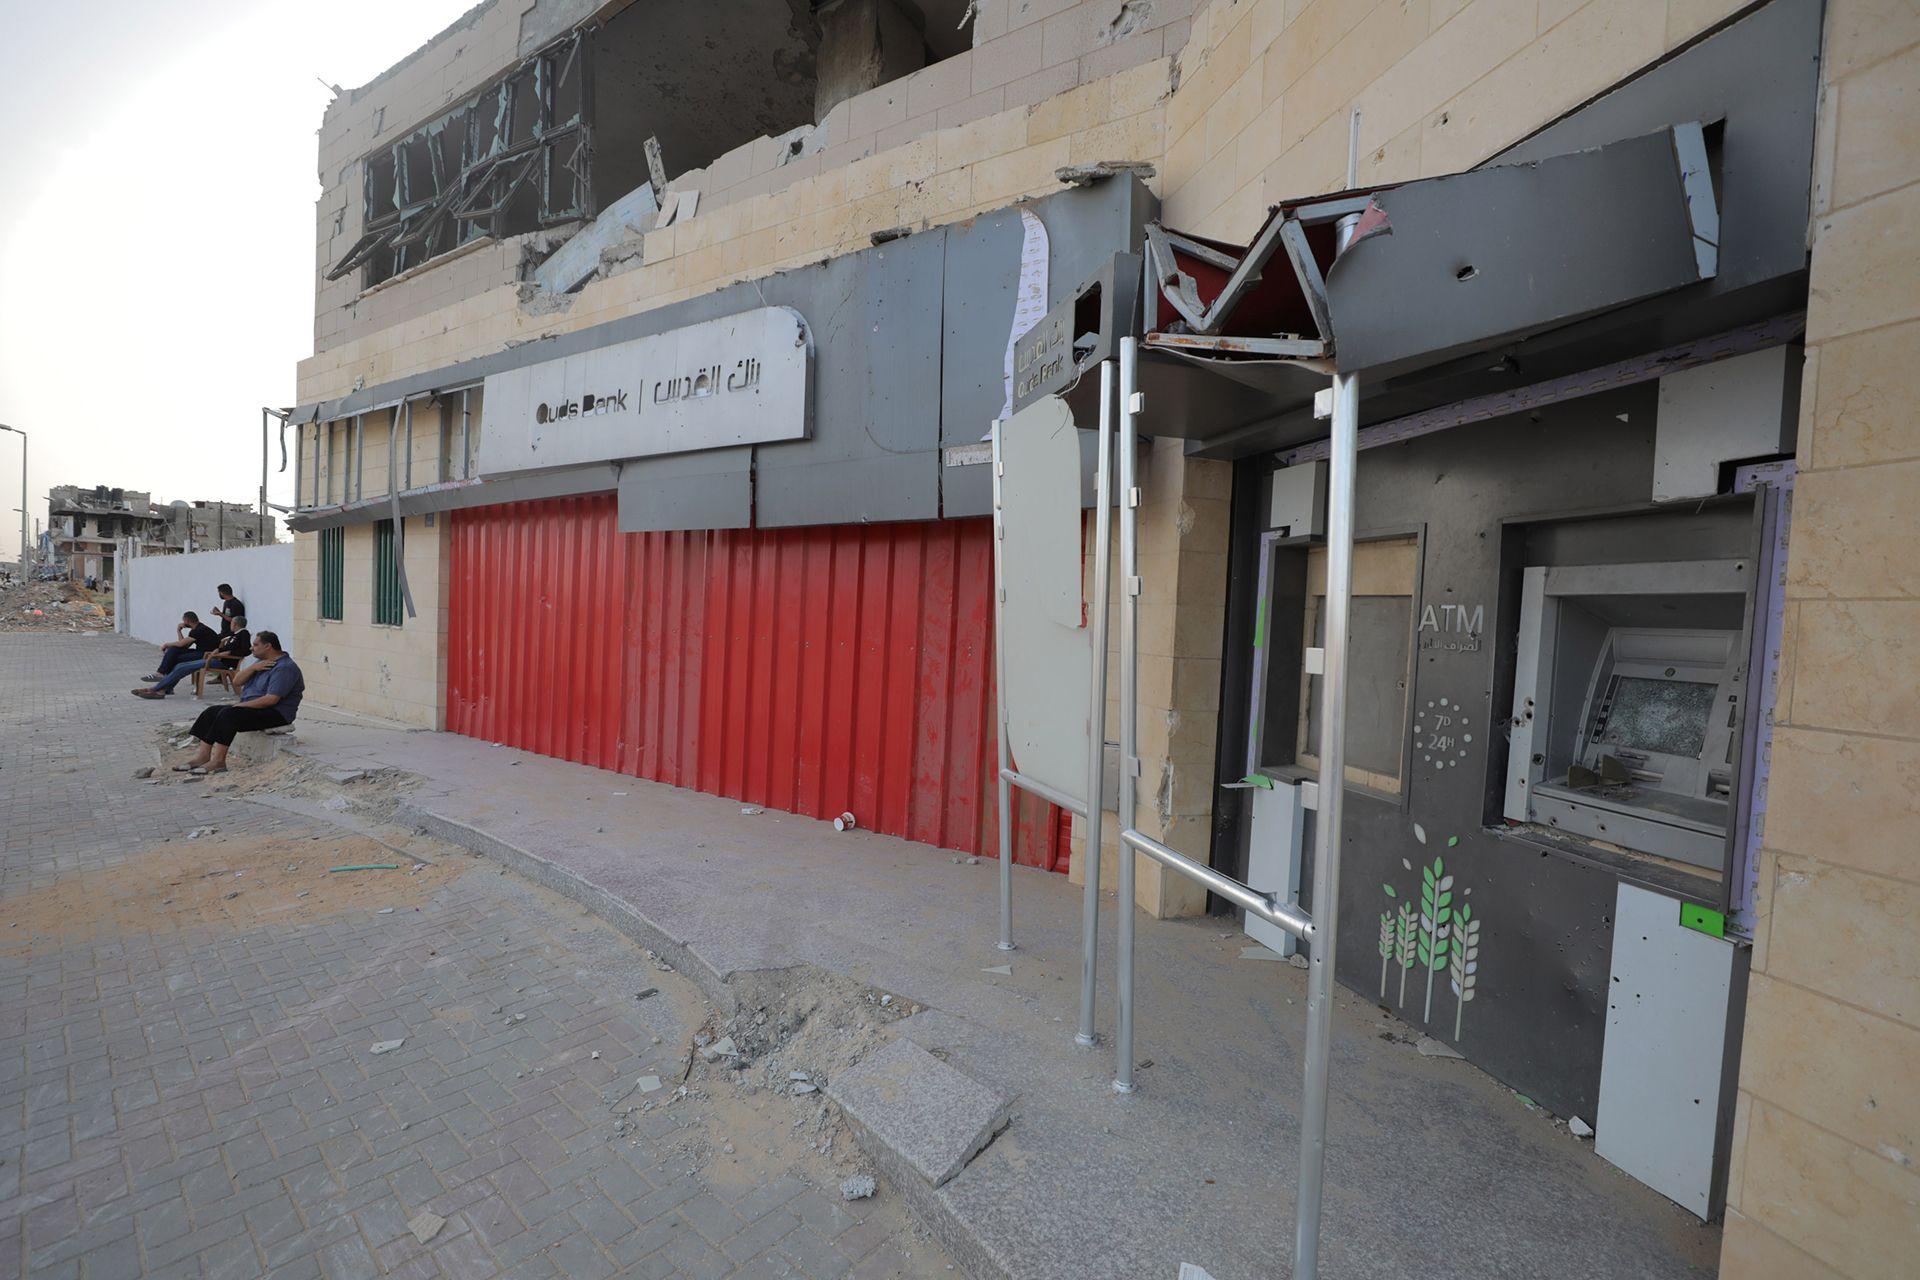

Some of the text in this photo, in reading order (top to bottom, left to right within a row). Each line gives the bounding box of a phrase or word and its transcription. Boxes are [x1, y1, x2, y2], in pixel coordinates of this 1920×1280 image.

[654, 357, 761, 405] بنك القدس
[536, 388, 628, 425] Quds Bank
[1418, 604, 1484, 634] ATM
[1434, 714, 1451, 730] 7D
[1428, 733, 1455, 752] 24H
